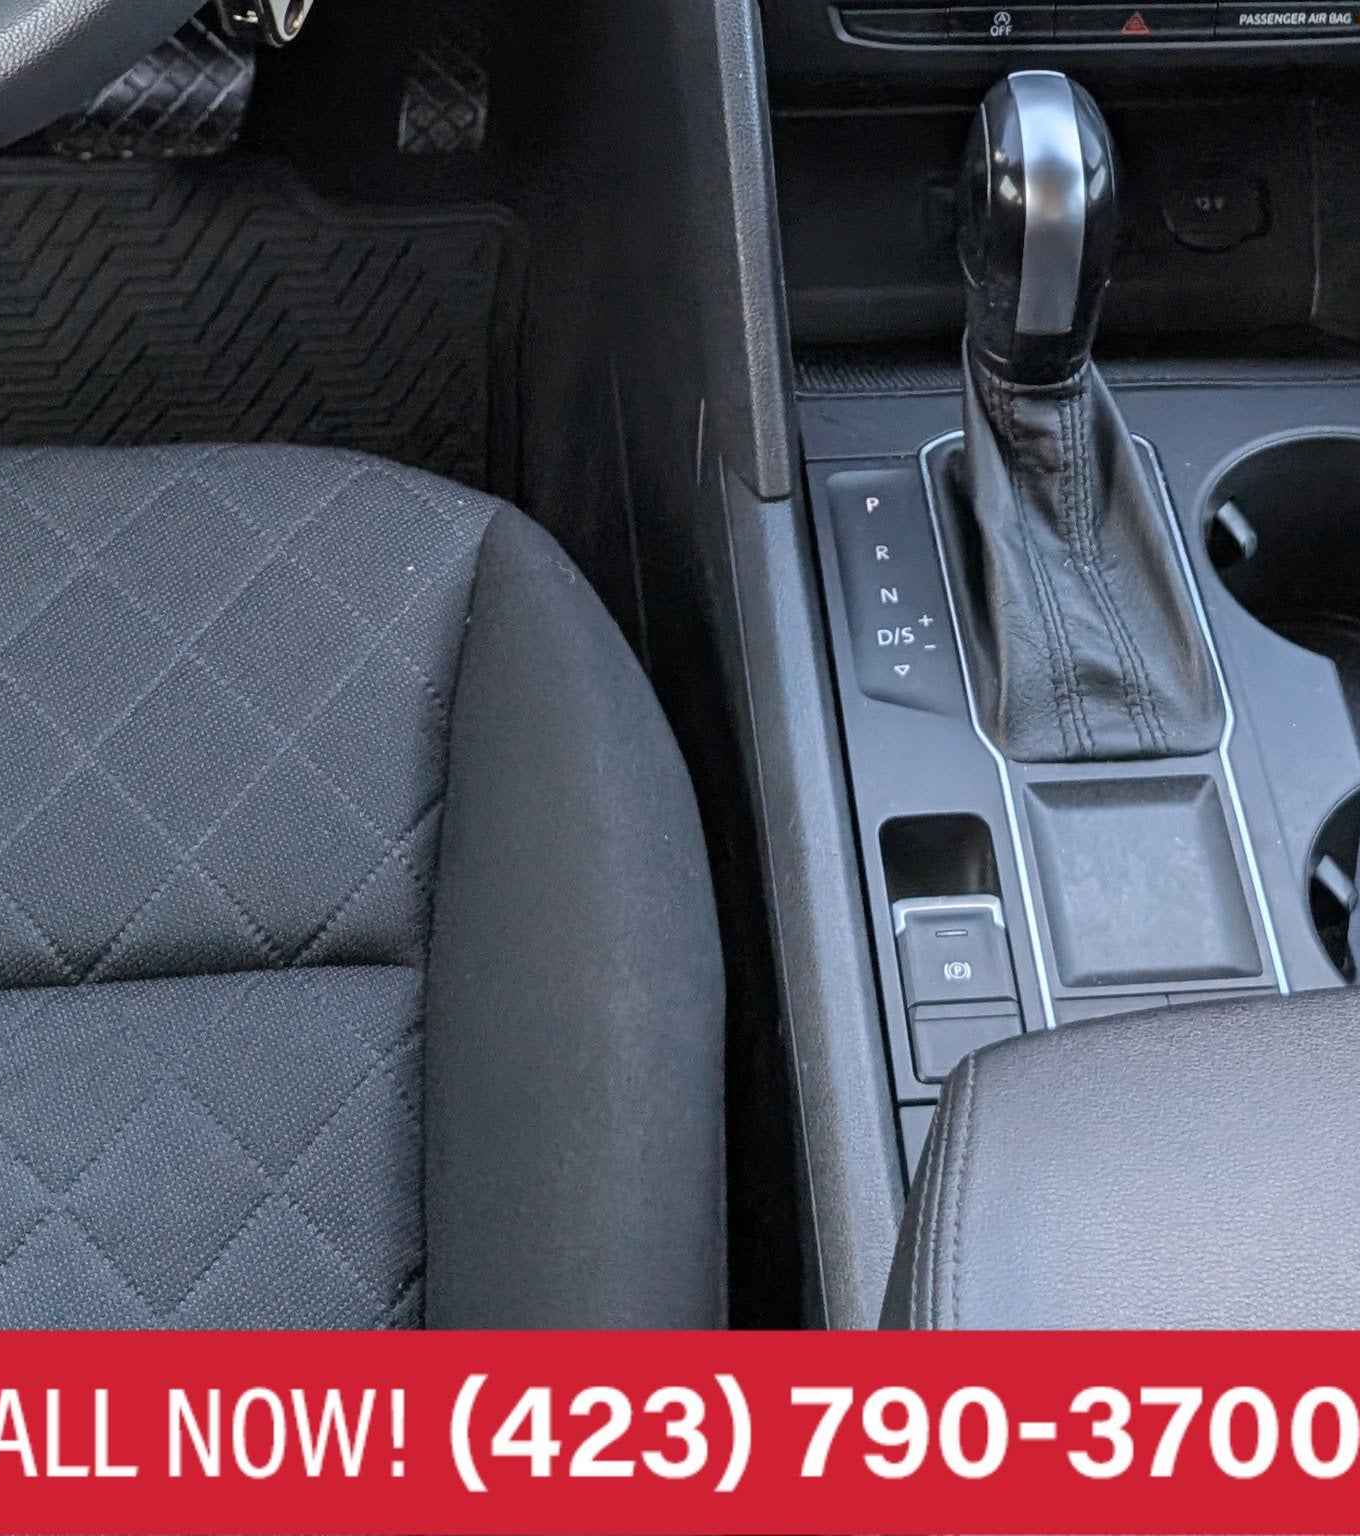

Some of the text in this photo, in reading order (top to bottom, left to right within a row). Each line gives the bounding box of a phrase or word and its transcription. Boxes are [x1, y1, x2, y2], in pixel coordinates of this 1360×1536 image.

[1239, 12, 1306, 26] PASSENGER
[1307, 12, 1327, 25] AIR
[1328, 12, 1352, 25] BAG
[989, 24, 1013, 37] OFF
[865, 497, 880, 514] P
[875, 545, 890, 561] R
[880, 587, 899, 604] N
[877, 626, 915, 646] D/S
